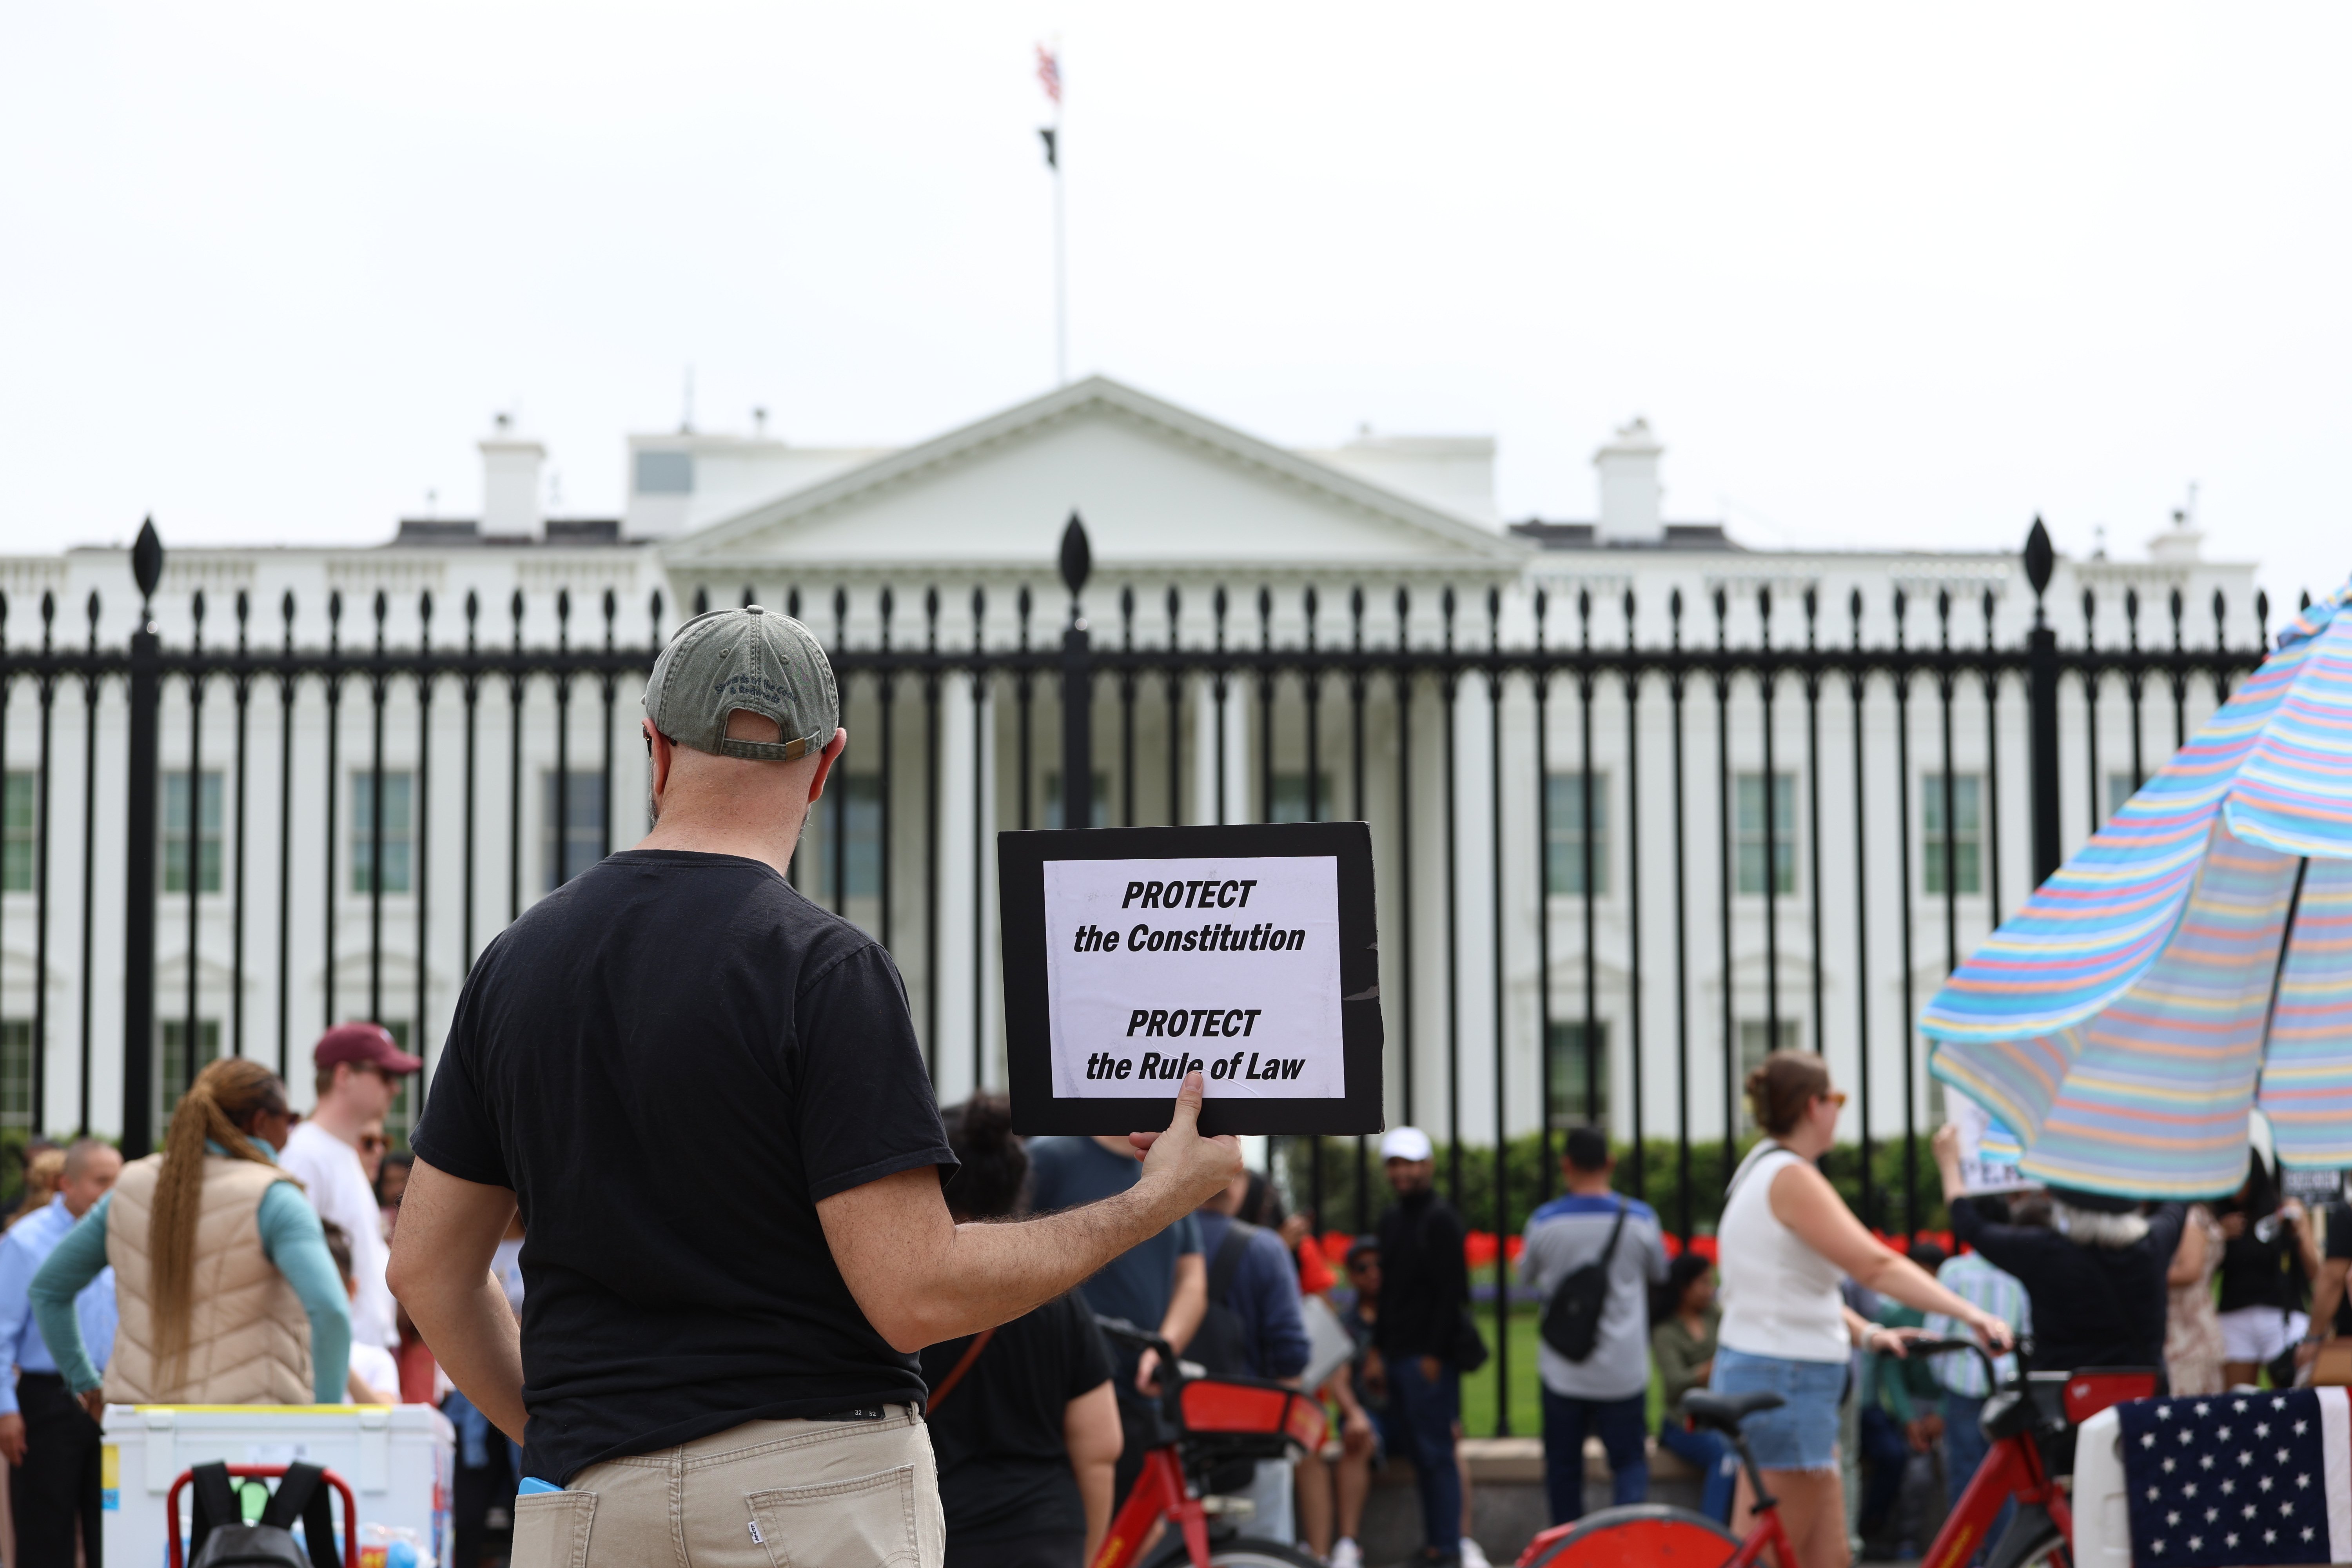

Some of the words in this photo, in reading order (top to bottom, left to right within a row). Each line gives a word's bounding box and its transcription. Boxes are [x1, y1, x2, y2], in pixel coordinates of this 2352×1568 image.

[714, 674, 749, 694] Stwards
[751, 677, 762, 686] of
[764, 679, 776, 691] the
[777, 686, 797, 702] Coat
[730, 686, 736, 695] &
[739, 684, 780, 704] Redwoods
[1122, 880, 1257, 909] PROTECT
[1074, 924, 1120, 952] the
[1127, 923, 1306, 952] Constitution
[1126, 1009, 1262, 1037] PROTECT
[1086, 1052, 1132, 1080] the
[1138, 1052, 1203, 1080] Rule
[1210, 1051, 1245, 1080] of
[1245, 1052, 1306, 1080] Law
